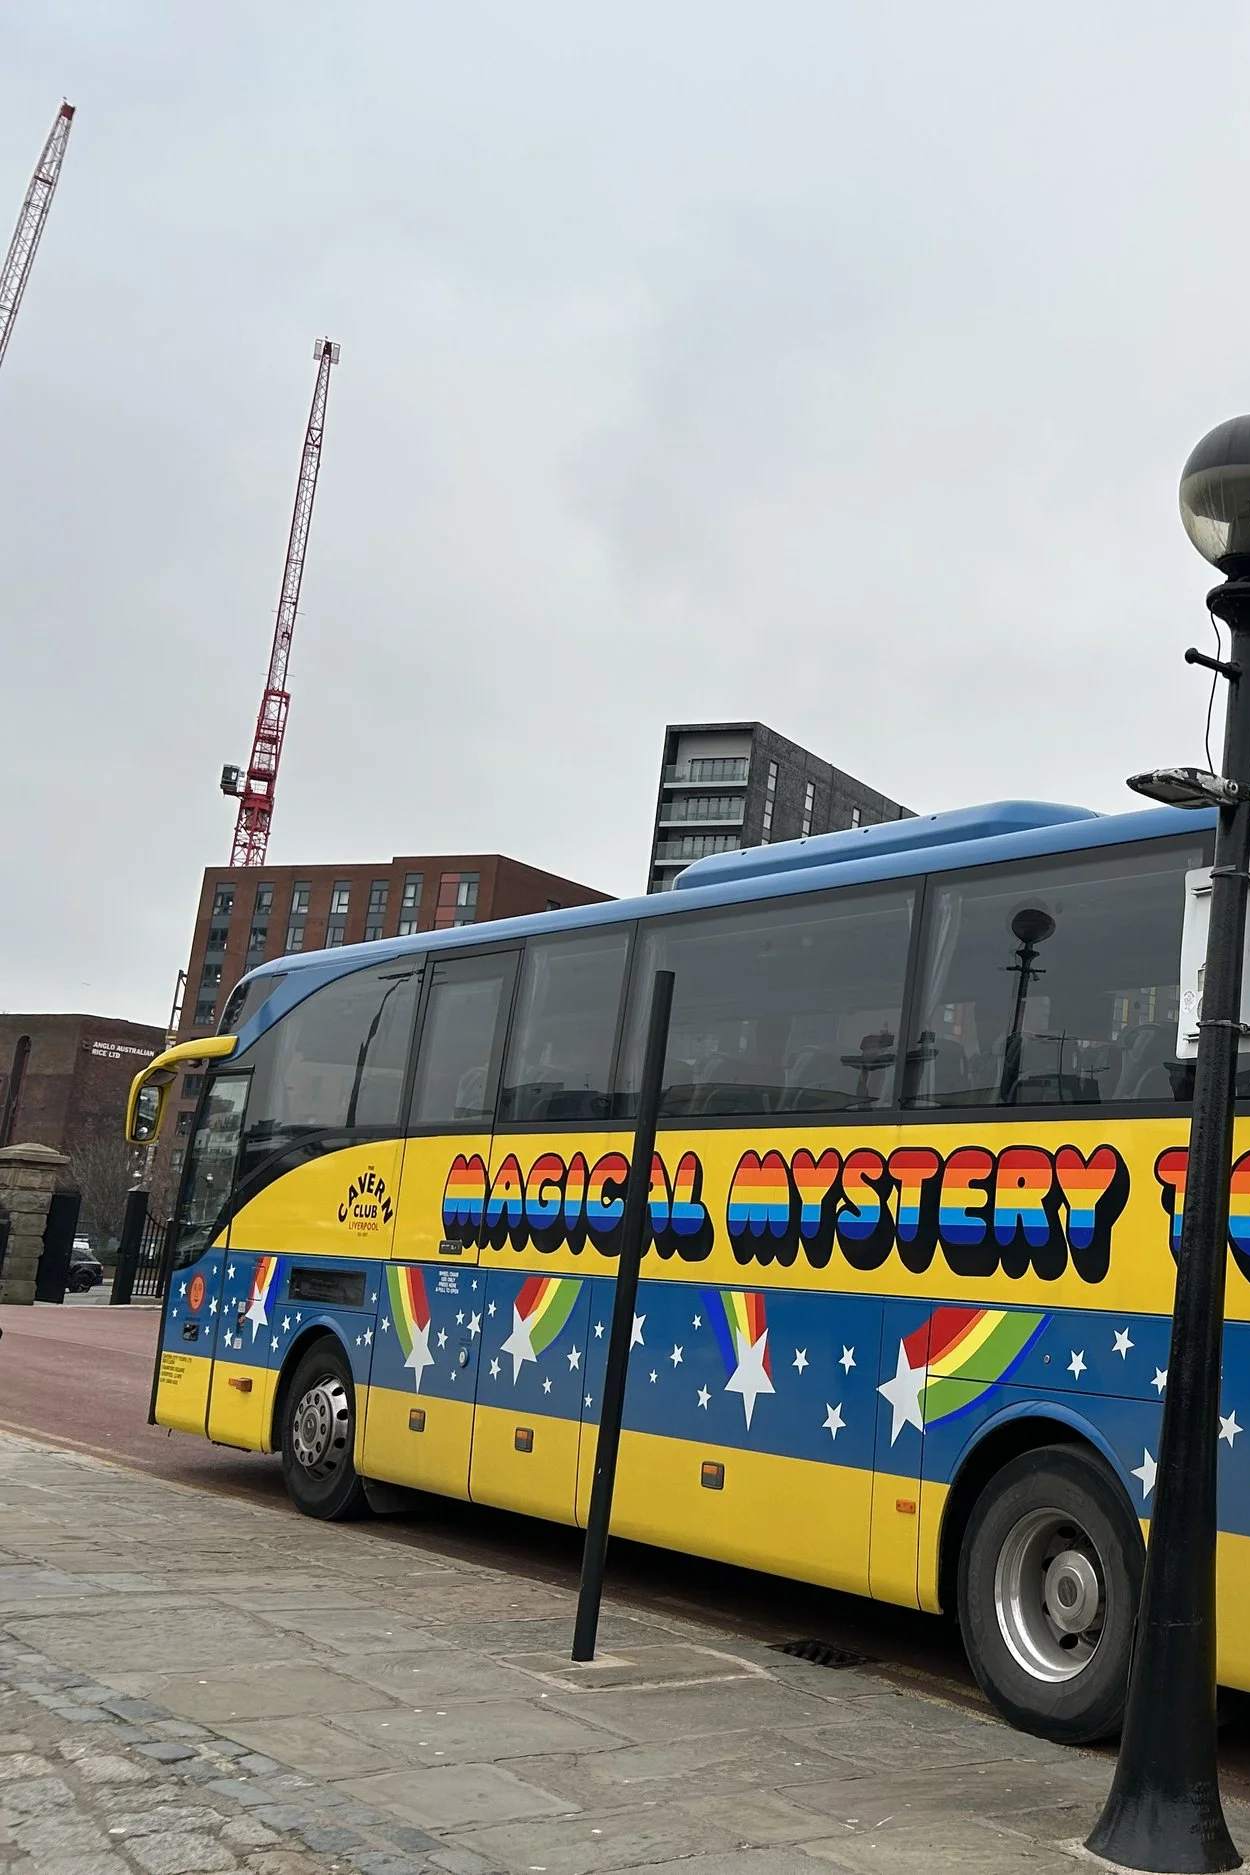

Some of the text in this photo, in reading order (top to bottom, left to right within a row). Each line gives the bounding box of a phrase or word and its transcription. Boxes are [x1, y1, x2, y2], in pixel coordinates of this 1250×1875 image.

[91, 1048, 121, 1059] RICE LTD
[93, 1041, 155, 1057] ANGLO AUSTRALIAN
[338, 1172, 393, 1225] CAVERN
[353, 1204, 378, 1219] CLUB
[442, 1151, 715, 1263] MAGICAL
[726, 1144, 1131, 1284] MYSTERY
[348, 1221, 380, 1232] LIVERPOOL
